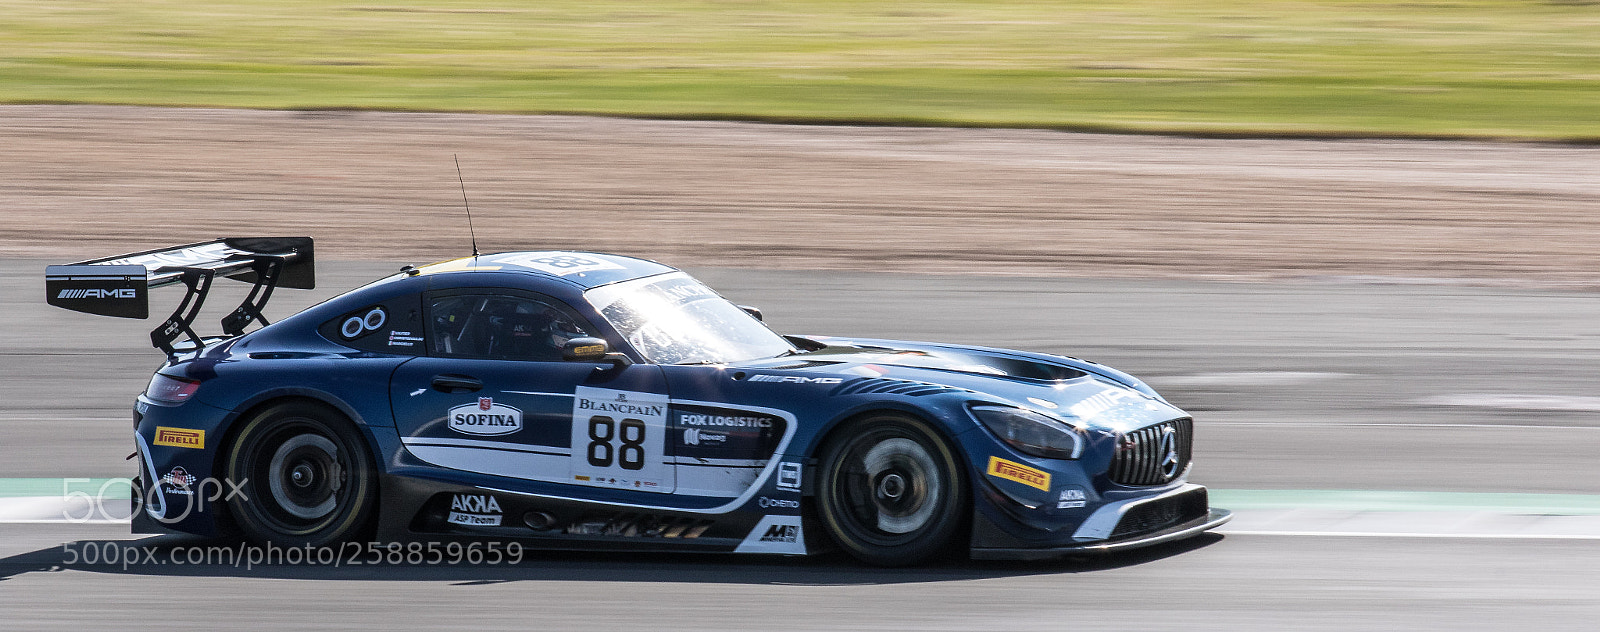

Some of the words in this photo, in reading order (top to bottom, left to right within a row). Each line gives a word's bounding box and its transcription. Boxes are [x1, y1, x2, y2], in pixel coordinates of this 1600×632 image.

[82, 288, 136, 299] AMG
[780, 376, 844, 384] AMG
[578, 398, 664, 417] BLANCPAIN
[454, 413, 517, 427] SOFINA
[680, 414, 707, 426] FOX
[708, 415, 773, 428] LOGISTICS
[158, 429, 200, 446] PIRELLI
[586, 414, 647, 471] 88
[995, 460, 1046, 486] PIRELLI
[451, 494, 503, 513] AKKA
[471, 515, 496, 525] Team
